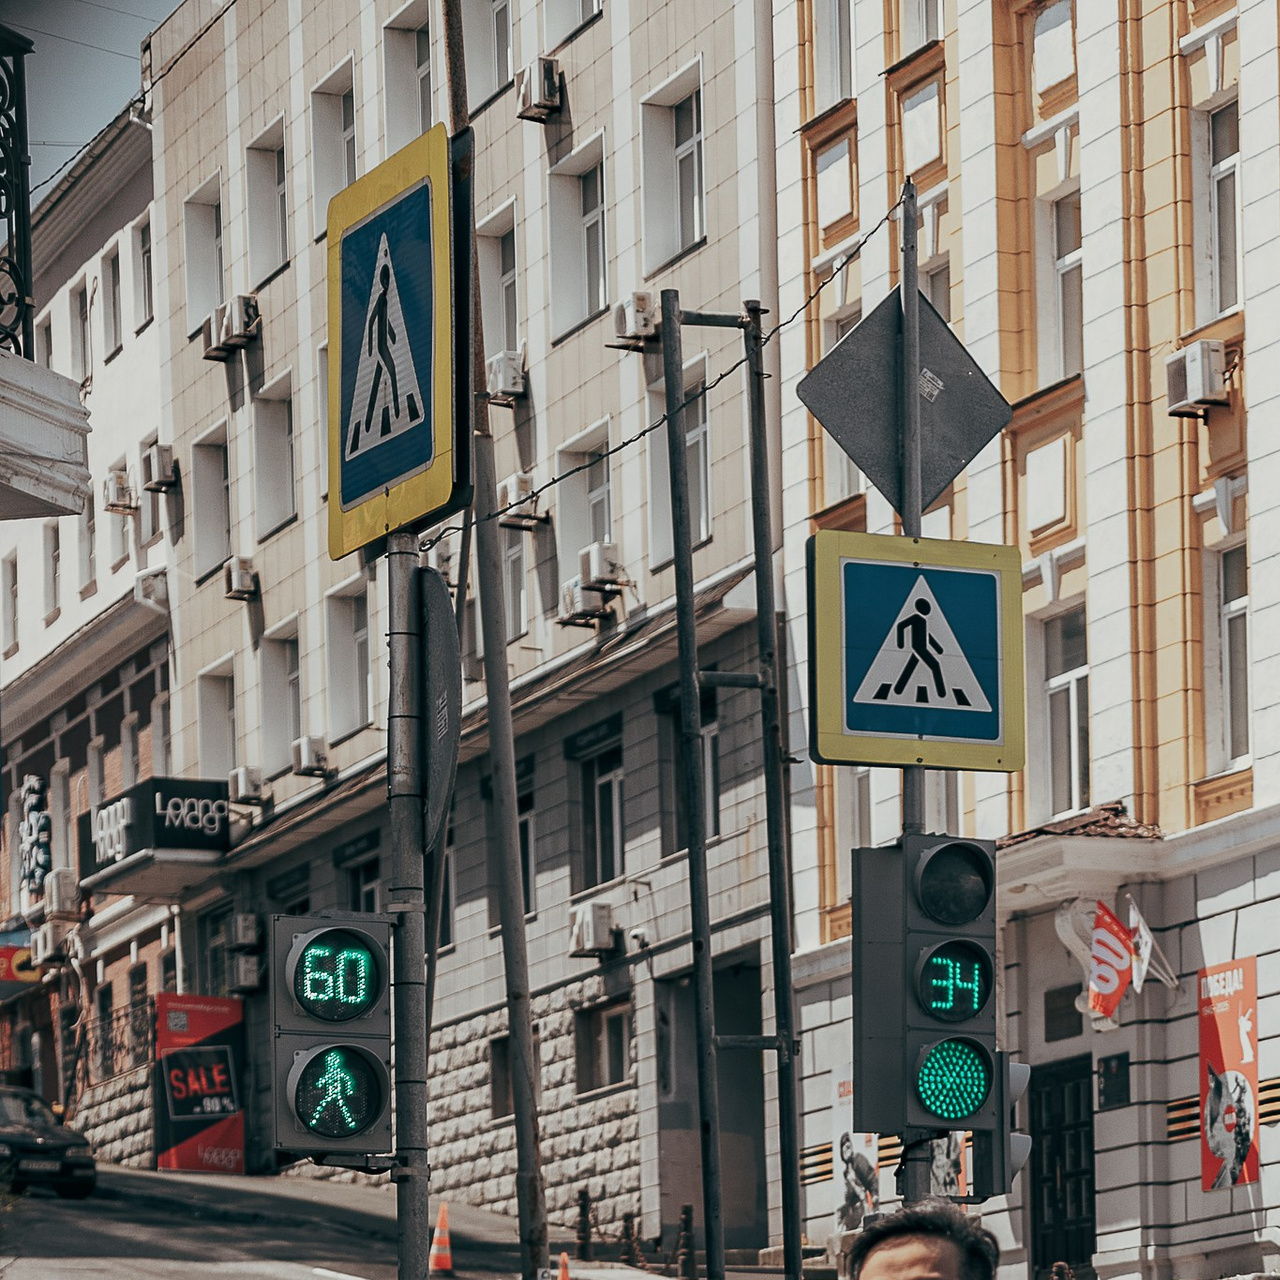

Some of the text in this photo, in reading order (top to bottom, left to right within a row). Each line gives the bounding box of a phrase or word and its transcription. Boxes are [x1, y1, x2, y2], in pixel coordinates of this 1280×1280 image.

[304, 948, 366, 1003] 60
[932, 957, 979, 1010] 34
[1201, 967, 1243, 999] ПОБЕДА!
[170, 1063, 229, 1099] SALE
